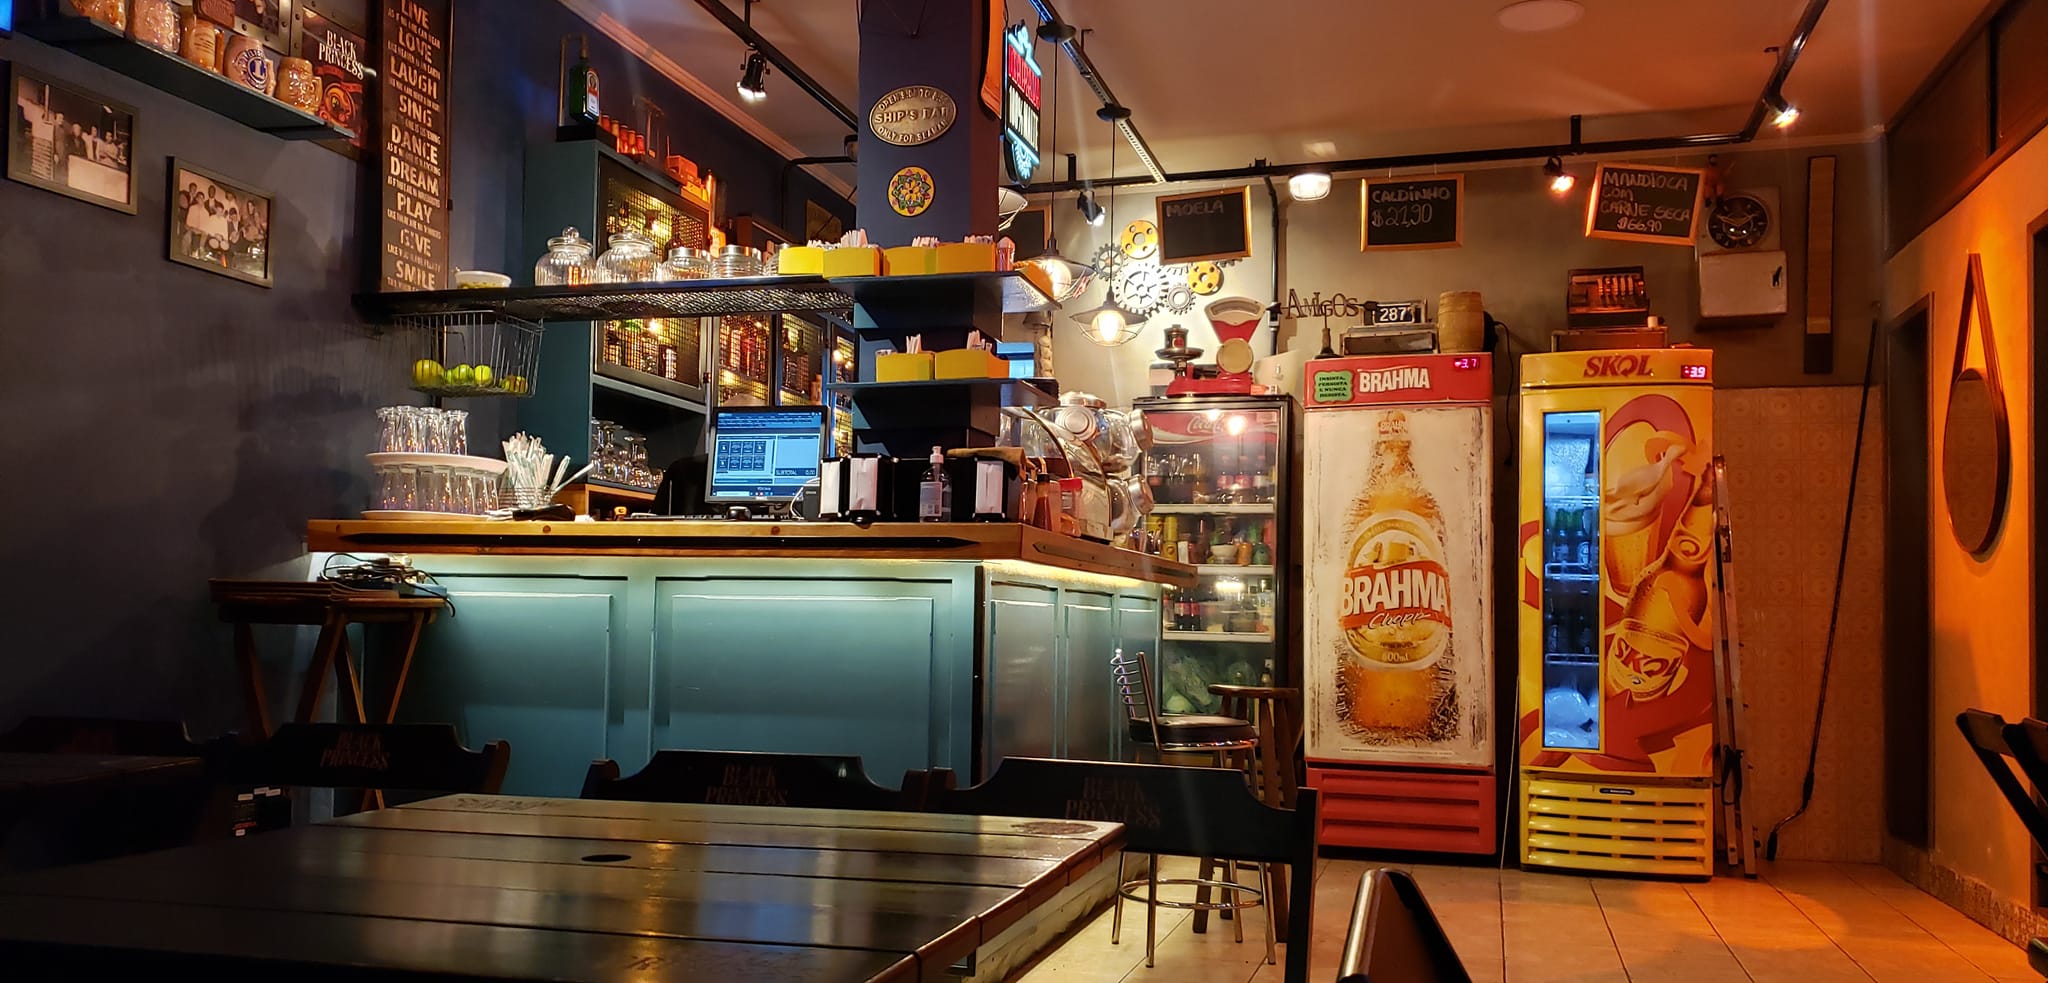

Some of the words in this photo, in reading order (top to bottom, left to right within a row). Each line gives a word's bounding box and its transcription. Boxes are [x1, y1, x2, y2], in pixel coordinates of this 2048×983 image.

[401, 0, 429, 30] LIVE
[326, 29, 357, 60] BLACK
[399, 27, 432, 64] LOVE
[391, 56, 437, 100] LAUGH
[399, 94, 432, 128] SING
[874, 109, 918, 124] SHIP'S
[391, 123, 438, 165] DANCE
[878, 126, 897, 141] ONLY
[391, 155, 438, 197] DREAM
[397, 192, 433, 224] PLAY
[1166, 199, 1225, 217] MOELA
[1601, 187, 1635, 201] COM
[1600, 200, 1652, 217] CARNE
[1653, 204, 1691, 221] SECA
[401, 228, 431, 257] GIVE
[396, 260, 435, 291] SMILE
[1359, 367, 1430, 393] BRAHMA
[1583, 354, 1653, 378] SKOL
[1342, 568, 1450, 617] BRAHMA
[1368, 612, 1432, 630] Chopp
[1614, 637, 1682, 678] SKOL
